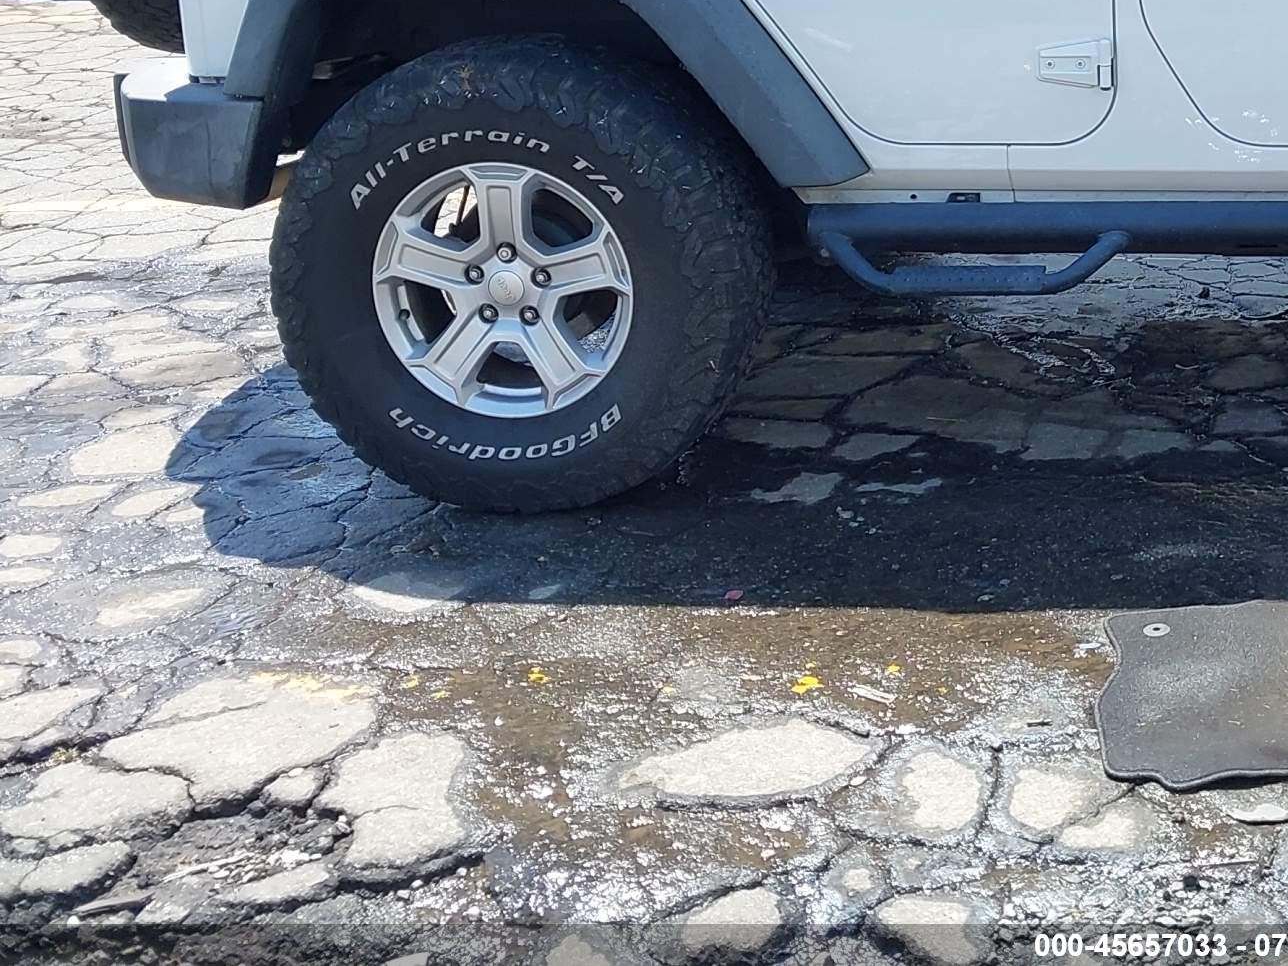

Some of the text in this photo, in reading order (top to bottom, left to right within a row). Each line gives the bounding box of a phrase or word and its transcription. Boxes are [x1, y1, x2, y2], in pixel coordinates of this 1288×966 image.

[350, 130, 624, 210] All-Terrain T/A
[389, 403, 622, 460] BFGoodrich
